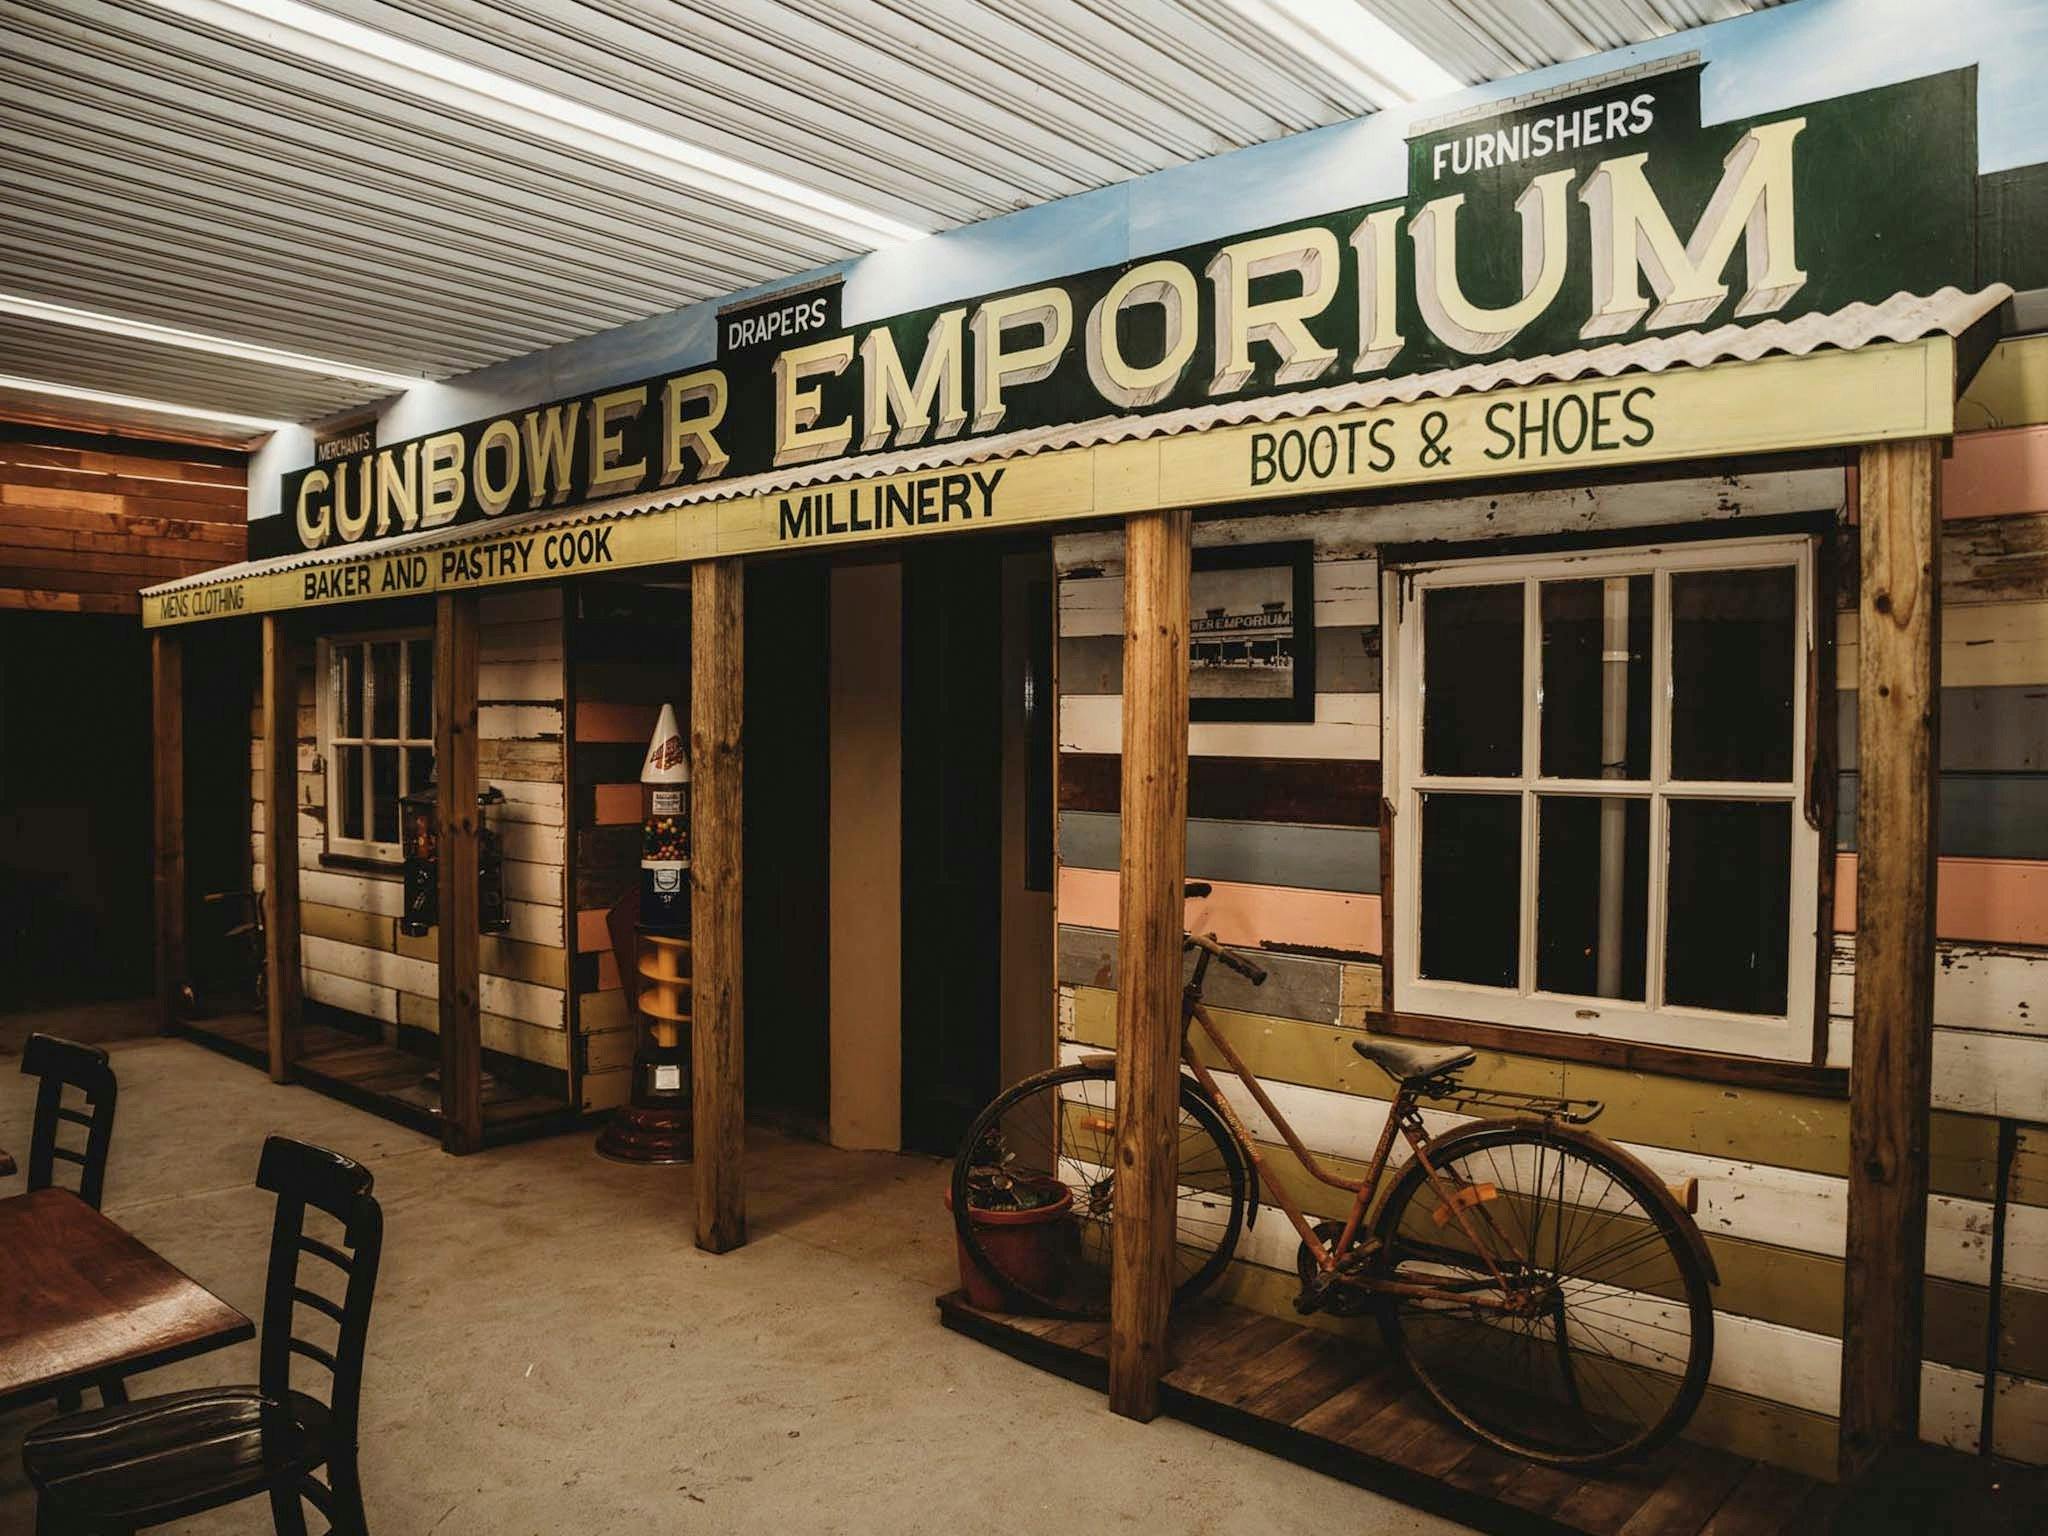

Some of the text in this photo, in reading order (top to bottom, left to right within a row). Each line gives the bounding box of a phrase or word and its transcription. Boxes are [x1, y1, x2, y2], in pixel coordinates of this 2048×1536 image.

[1432, 94, 1656, 181] FURNISHERS
[296, 116, 1808, 549] GUNBOWER EMPORIUM
[728, 298, 828, 350] DRAPERS
[318, 431, 371, 462] MERCHANTS
[1250, 386, 1656, 486] BOOTS & SHOES
[779, 468, 1006, 541] MILLINERY
[303, 526, 614, 601] BAKER AND PASTRY COOK
[160, 585, 244, 619] MENS CLOTHING
[1215, 613, 1290, 628] EMPORIUM
